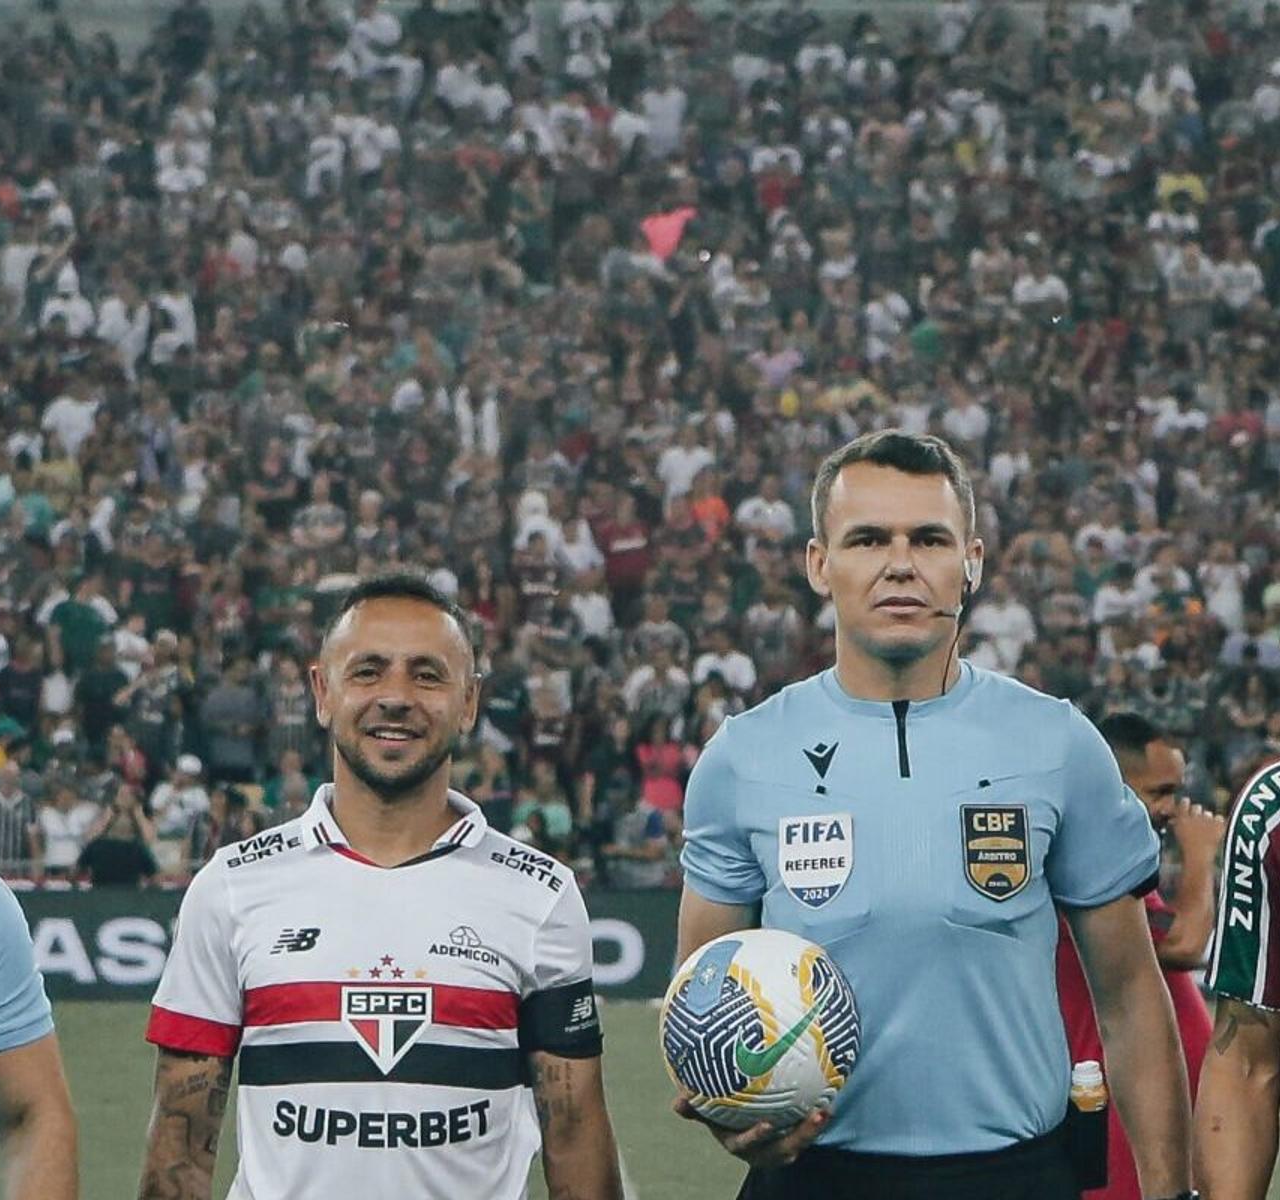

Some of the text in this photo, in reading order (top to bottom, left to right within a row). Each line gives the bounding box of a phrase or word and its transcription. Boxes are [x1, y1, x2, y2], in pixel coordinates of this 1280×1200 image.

[785, 820, 846, 845] FIFA
[972, 812, 1016, 832] CBF
[238, 832, 285, 854] VIVA
[508, 847, 556, 870] VIVA
[784, 856, 846, 872] REFEREE
[489, 852, 564, 893] SORTE
[802, 888, 830, 901] 2024
[428, 944, 500, 967] ADEMICON
[350, 994, 425, 1013] SPFC
[272, 1099, 491, 1149] SUPERBET
